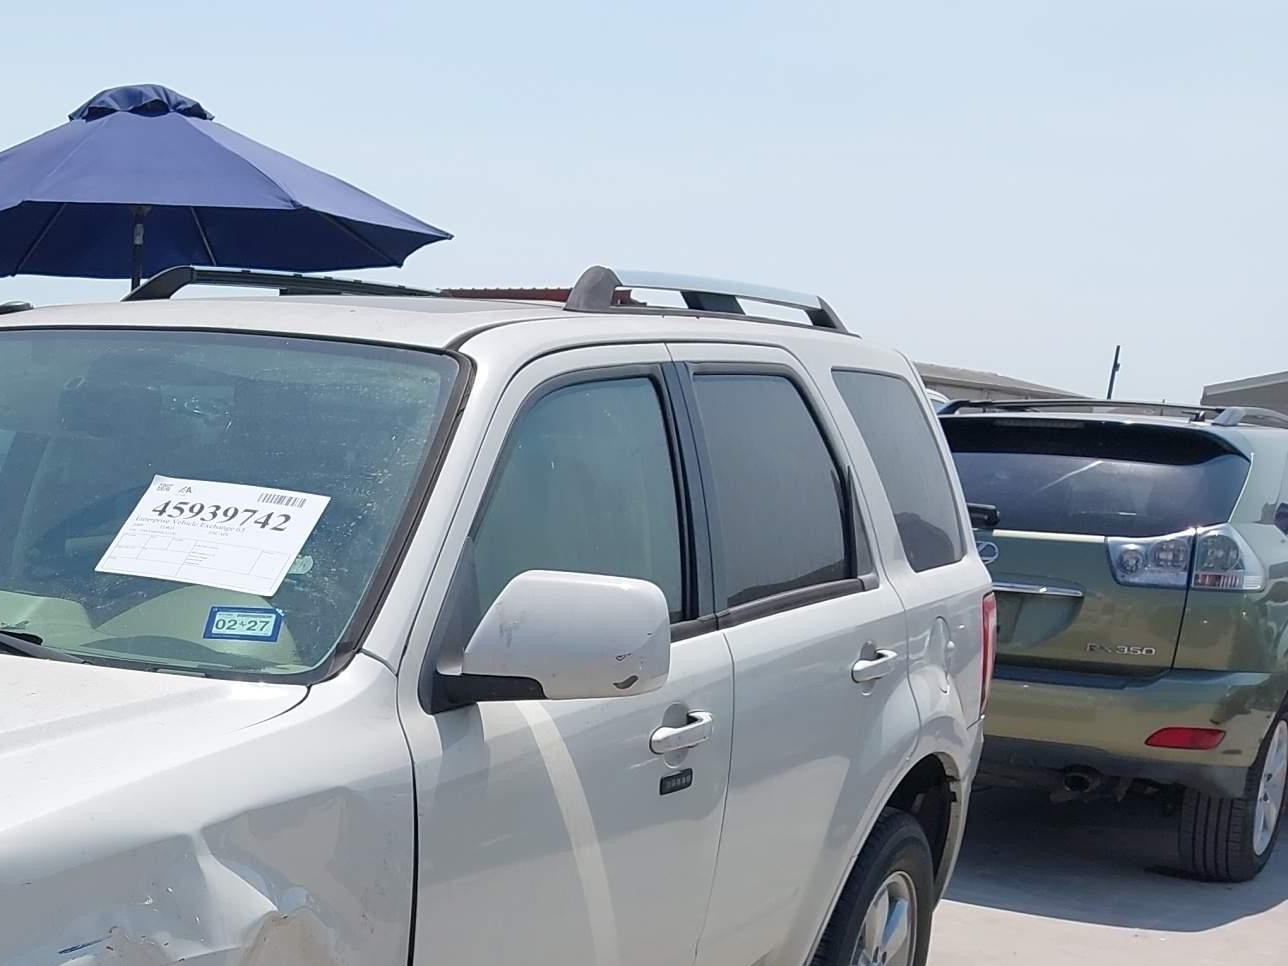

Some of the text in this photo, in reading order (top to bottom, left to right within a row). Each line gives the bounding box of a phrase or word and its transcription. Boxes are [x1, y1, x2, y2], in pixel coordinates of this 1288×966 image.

[151, 500, 292, 532] 45939742
[173, 518, 198, 527] Vehicle
[200, 522, 235, 532] Exchange
[215, 618, 270, 632] 02 27
